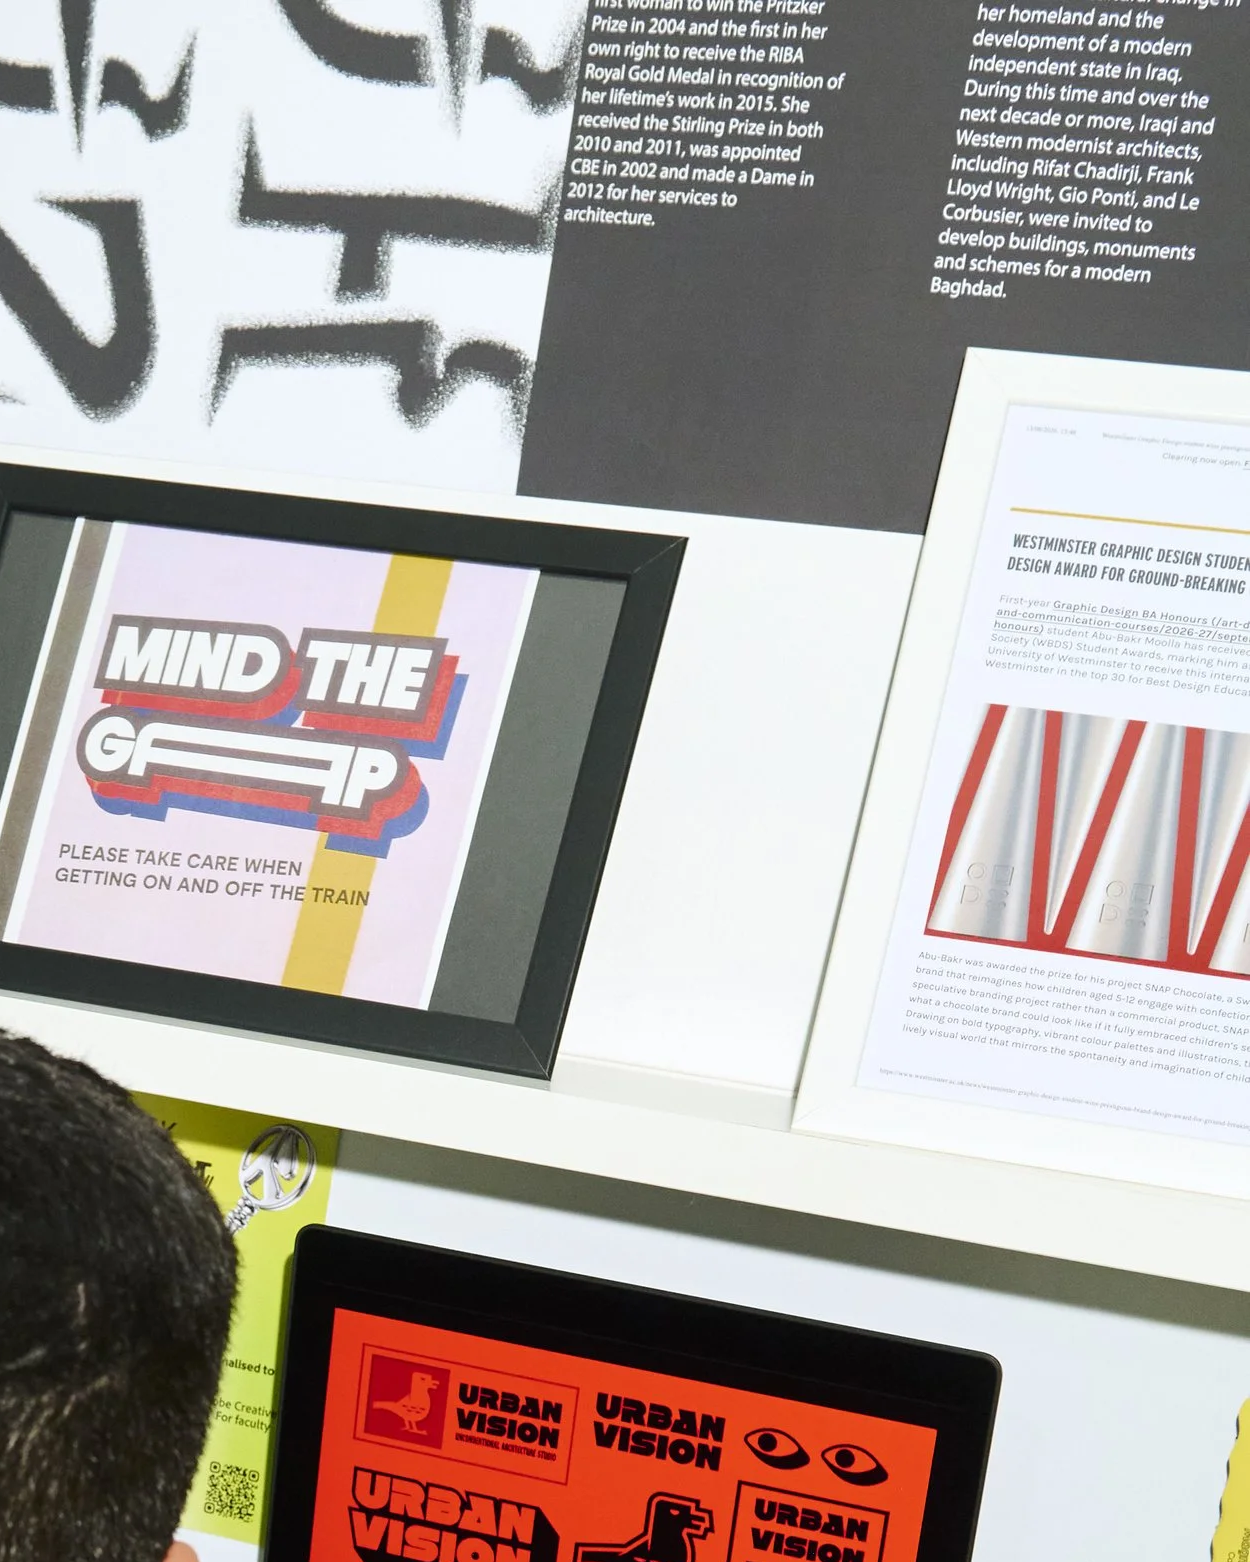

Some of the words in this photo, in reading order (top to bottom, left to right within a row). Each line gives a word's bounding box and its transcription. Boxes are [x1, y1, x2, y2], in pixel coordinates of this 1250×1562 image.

[577, 112, 640, 129] received
[643, 113, 668, 131] the
[671, 115, 725, 137] Stirling
[728, 117, 765, 135] Prize
[768, 119, 783, 136] in
[786, 120, 823, 138] both
[573, 134, 611, 152] 2010
[613, 137, 643, 153] and
[645, 138, 685, 157] 2011,
[689, 143, 718, 157] was
[721, 144, 801, 162] appointed
[956, 128, 1022, 149] Western
[1026, 134, 1113, 154] modernist
[1115, 139, 1202, 162] architects,
[951, 153, 1028, 178] including
[1032, 158, 1071, 177] Rifat
[1074, 161, 1142, 185] Chadirji,
[1146, 165, 1194, 184] Frank
[563, 205, 655, 226] architecture.
[938, 227, 1005, 251] develop
[1008, 231, 1089, 257] buildings,
[1093, 242, 1196, 260] monuments
[930, 276, 1006, 298] Baghdad.
[1013, 533, 1096, 555] WESTMINSTER
[1099, 542, 1153, 561] GRAPHIC
[1156, 548, 1202, 566] DESIGN
[1006, 556, 1051, 573] DESIGN
[1053, 561, 1097, 578] AWARD
[1100, 566, 1125, 581] FOR
[1128, 568, 1246, 594] GROUND-BREAKING
[103, 625, 280, 693] MIND
[306, 640, 432, 711] THE
[58, 843, 129, 863] PLEASE
[135, 849, 182, 867] TAKE
[187, 853, 239, 871] CARE
[245, 857, 302, 876] WHEN
[55, 867, 136, 887] GETTING
[143, 874, 172, 890] ON
[176, 877, 218, 893] AND
[225, 880, 264, 897] OFF
[269, 884, 306, 901] THE
[312, 887, 369, 905] TRAIN
[263, 1364, 276, 1376] to
[216, 1411, 232, 1423] For
[458, 1383, 563, 1424] URBAN
[596, 1392, 726, 1443] URBAN
[456, 1408, 560, 1449] VISION
[593, 1420, 722, 1472] VISION
[353, 1467, 540, 1545] URBAN
[754, 1497, 869, 1542] URBAN
